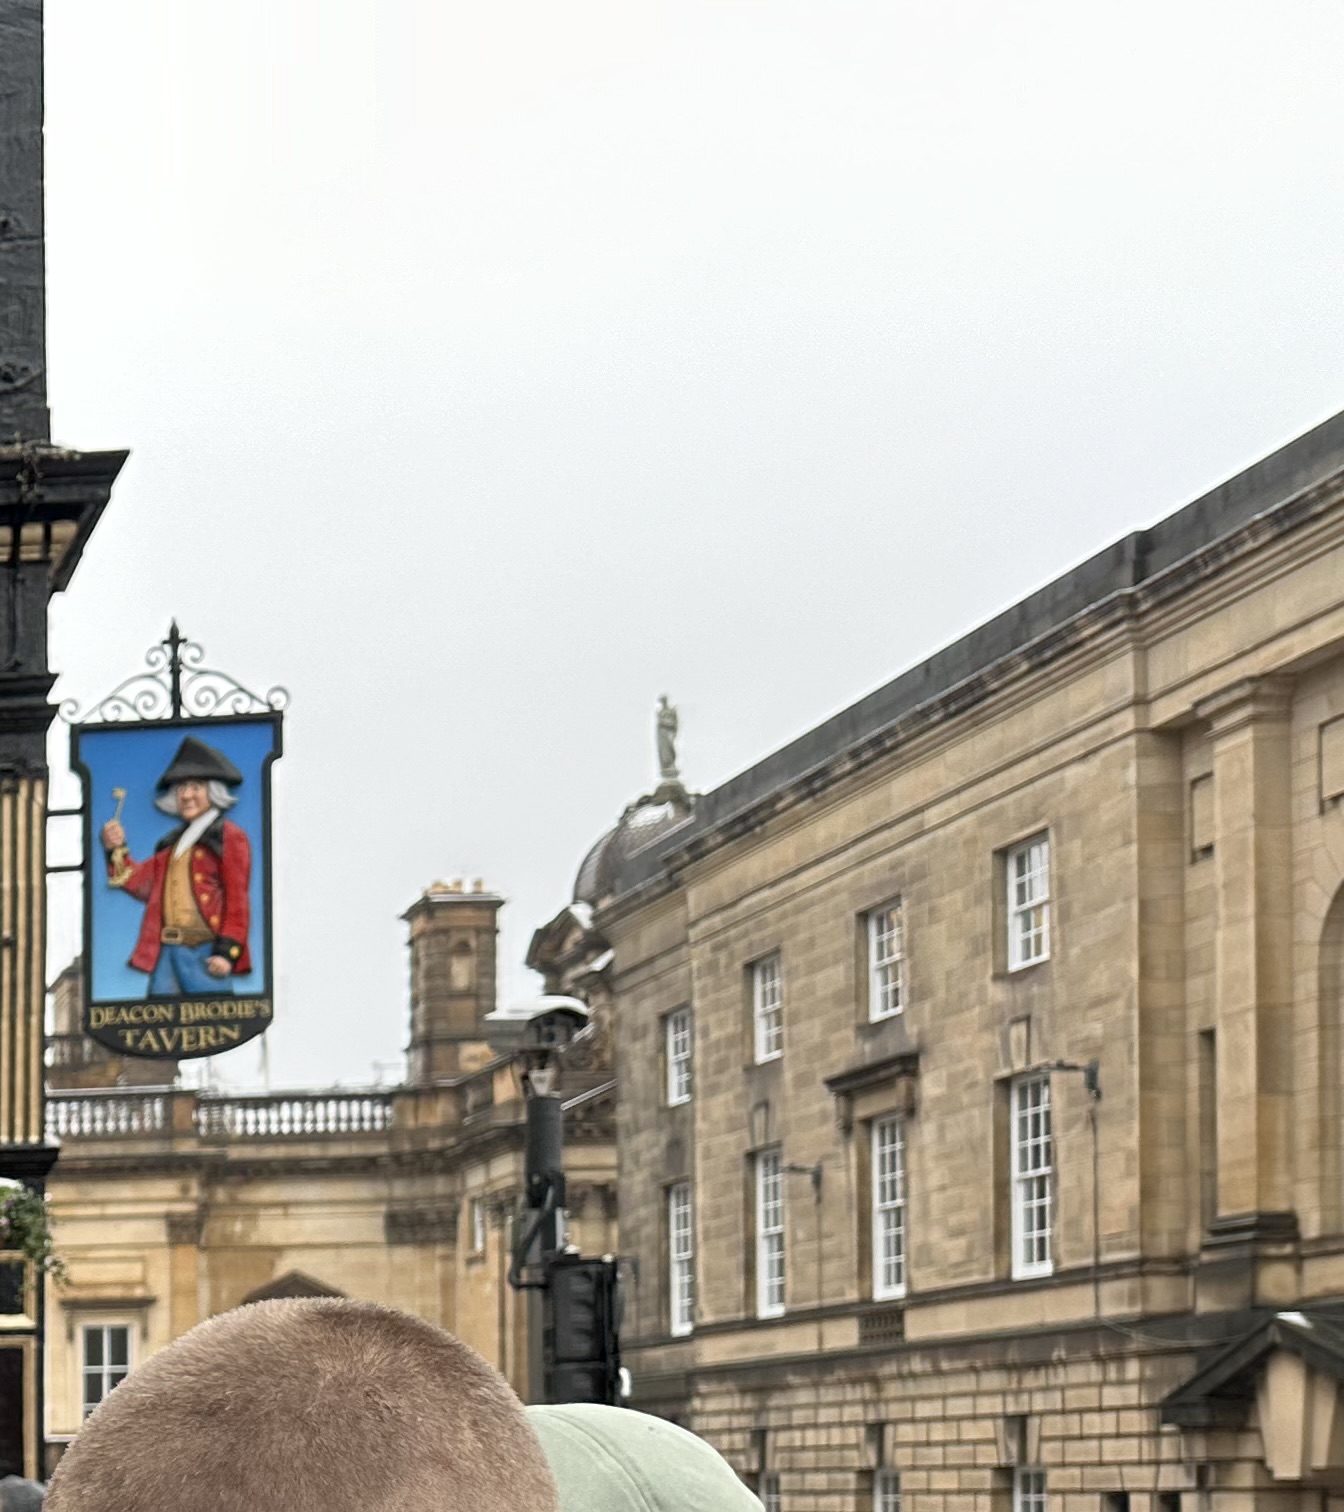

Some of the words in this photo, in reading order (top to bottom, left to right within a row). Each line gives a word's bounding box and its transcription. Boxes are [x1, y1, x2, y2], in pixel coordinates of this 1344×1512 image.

[89, 1003, 175, 1030] DEACON
[180, 999, 271, 1025] BRODIE'S
[118, 1023, 242, 1053] TAVERN
